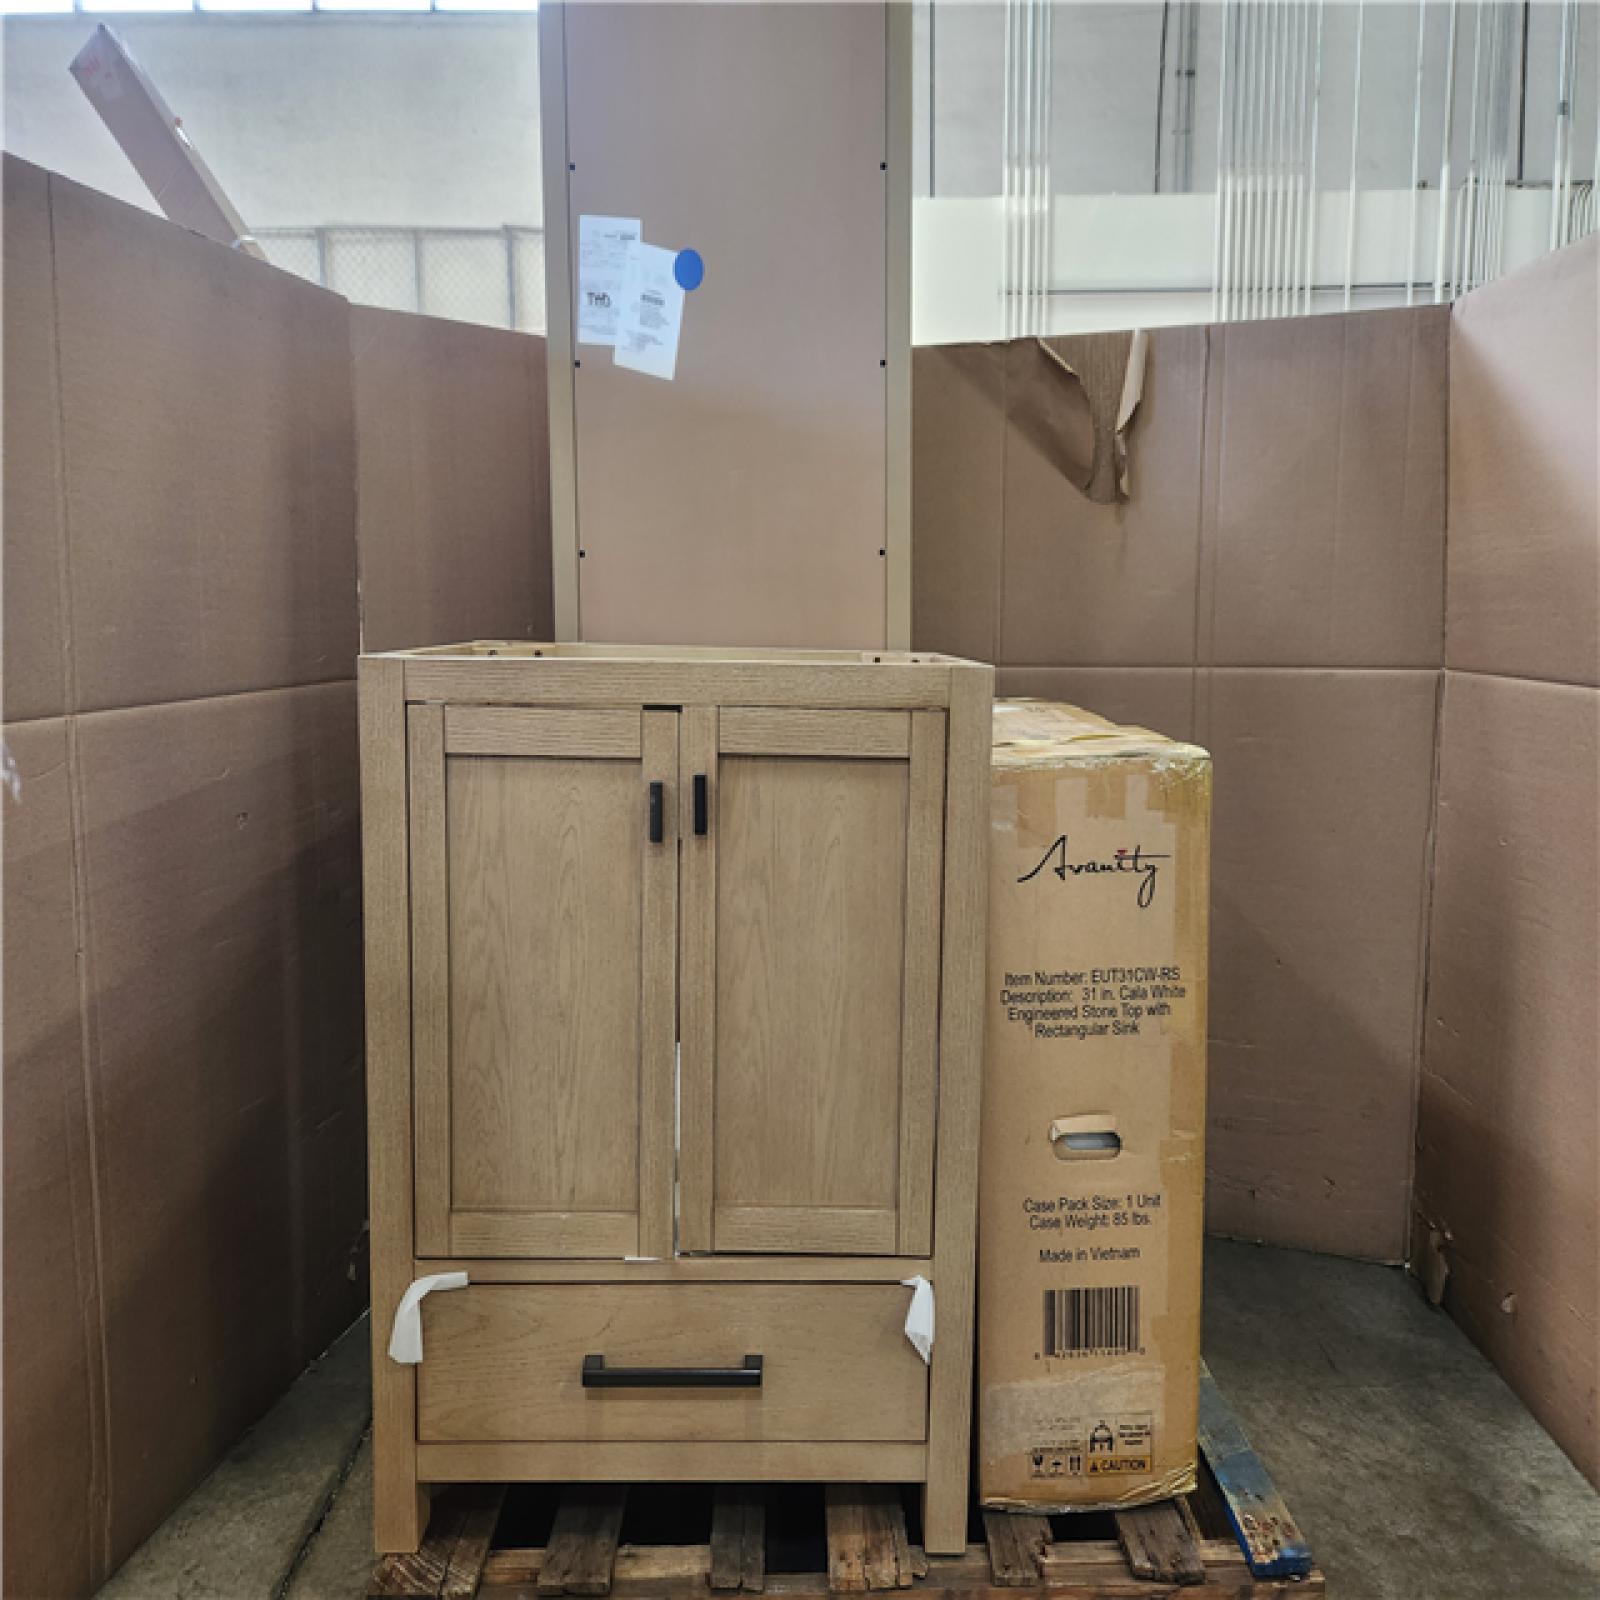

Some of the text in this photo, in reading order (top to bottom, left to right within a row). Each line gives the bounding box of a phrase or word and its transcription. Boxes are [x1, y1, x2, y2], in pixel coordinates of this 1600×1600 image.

[1004, 971, 1032, 986] Item
[1034, 970, 1087, 985] Number:
[1000, 989, 1073, 1005] Description:
[1082, 987, 1097, 1001] 31
[1100, 987, 1115, 1000] in.
[1152, 984, 1186, 999] White
[1008, 1003, 1171, 1024] Engineered Stone Top with
[1034, 1020, 1139, 1040] Rectangular Sink
[1023, 1194, 1161, 1213] Case Pack Size: 1 Unit
[1029, 1216, 1061, 1230] Case
[1065, 1213, 1110, 1230] Weight:
[1112, 1213, 1128, 1226] 85
[1039, 1246, 1141, 1263] Made in Vietnam
